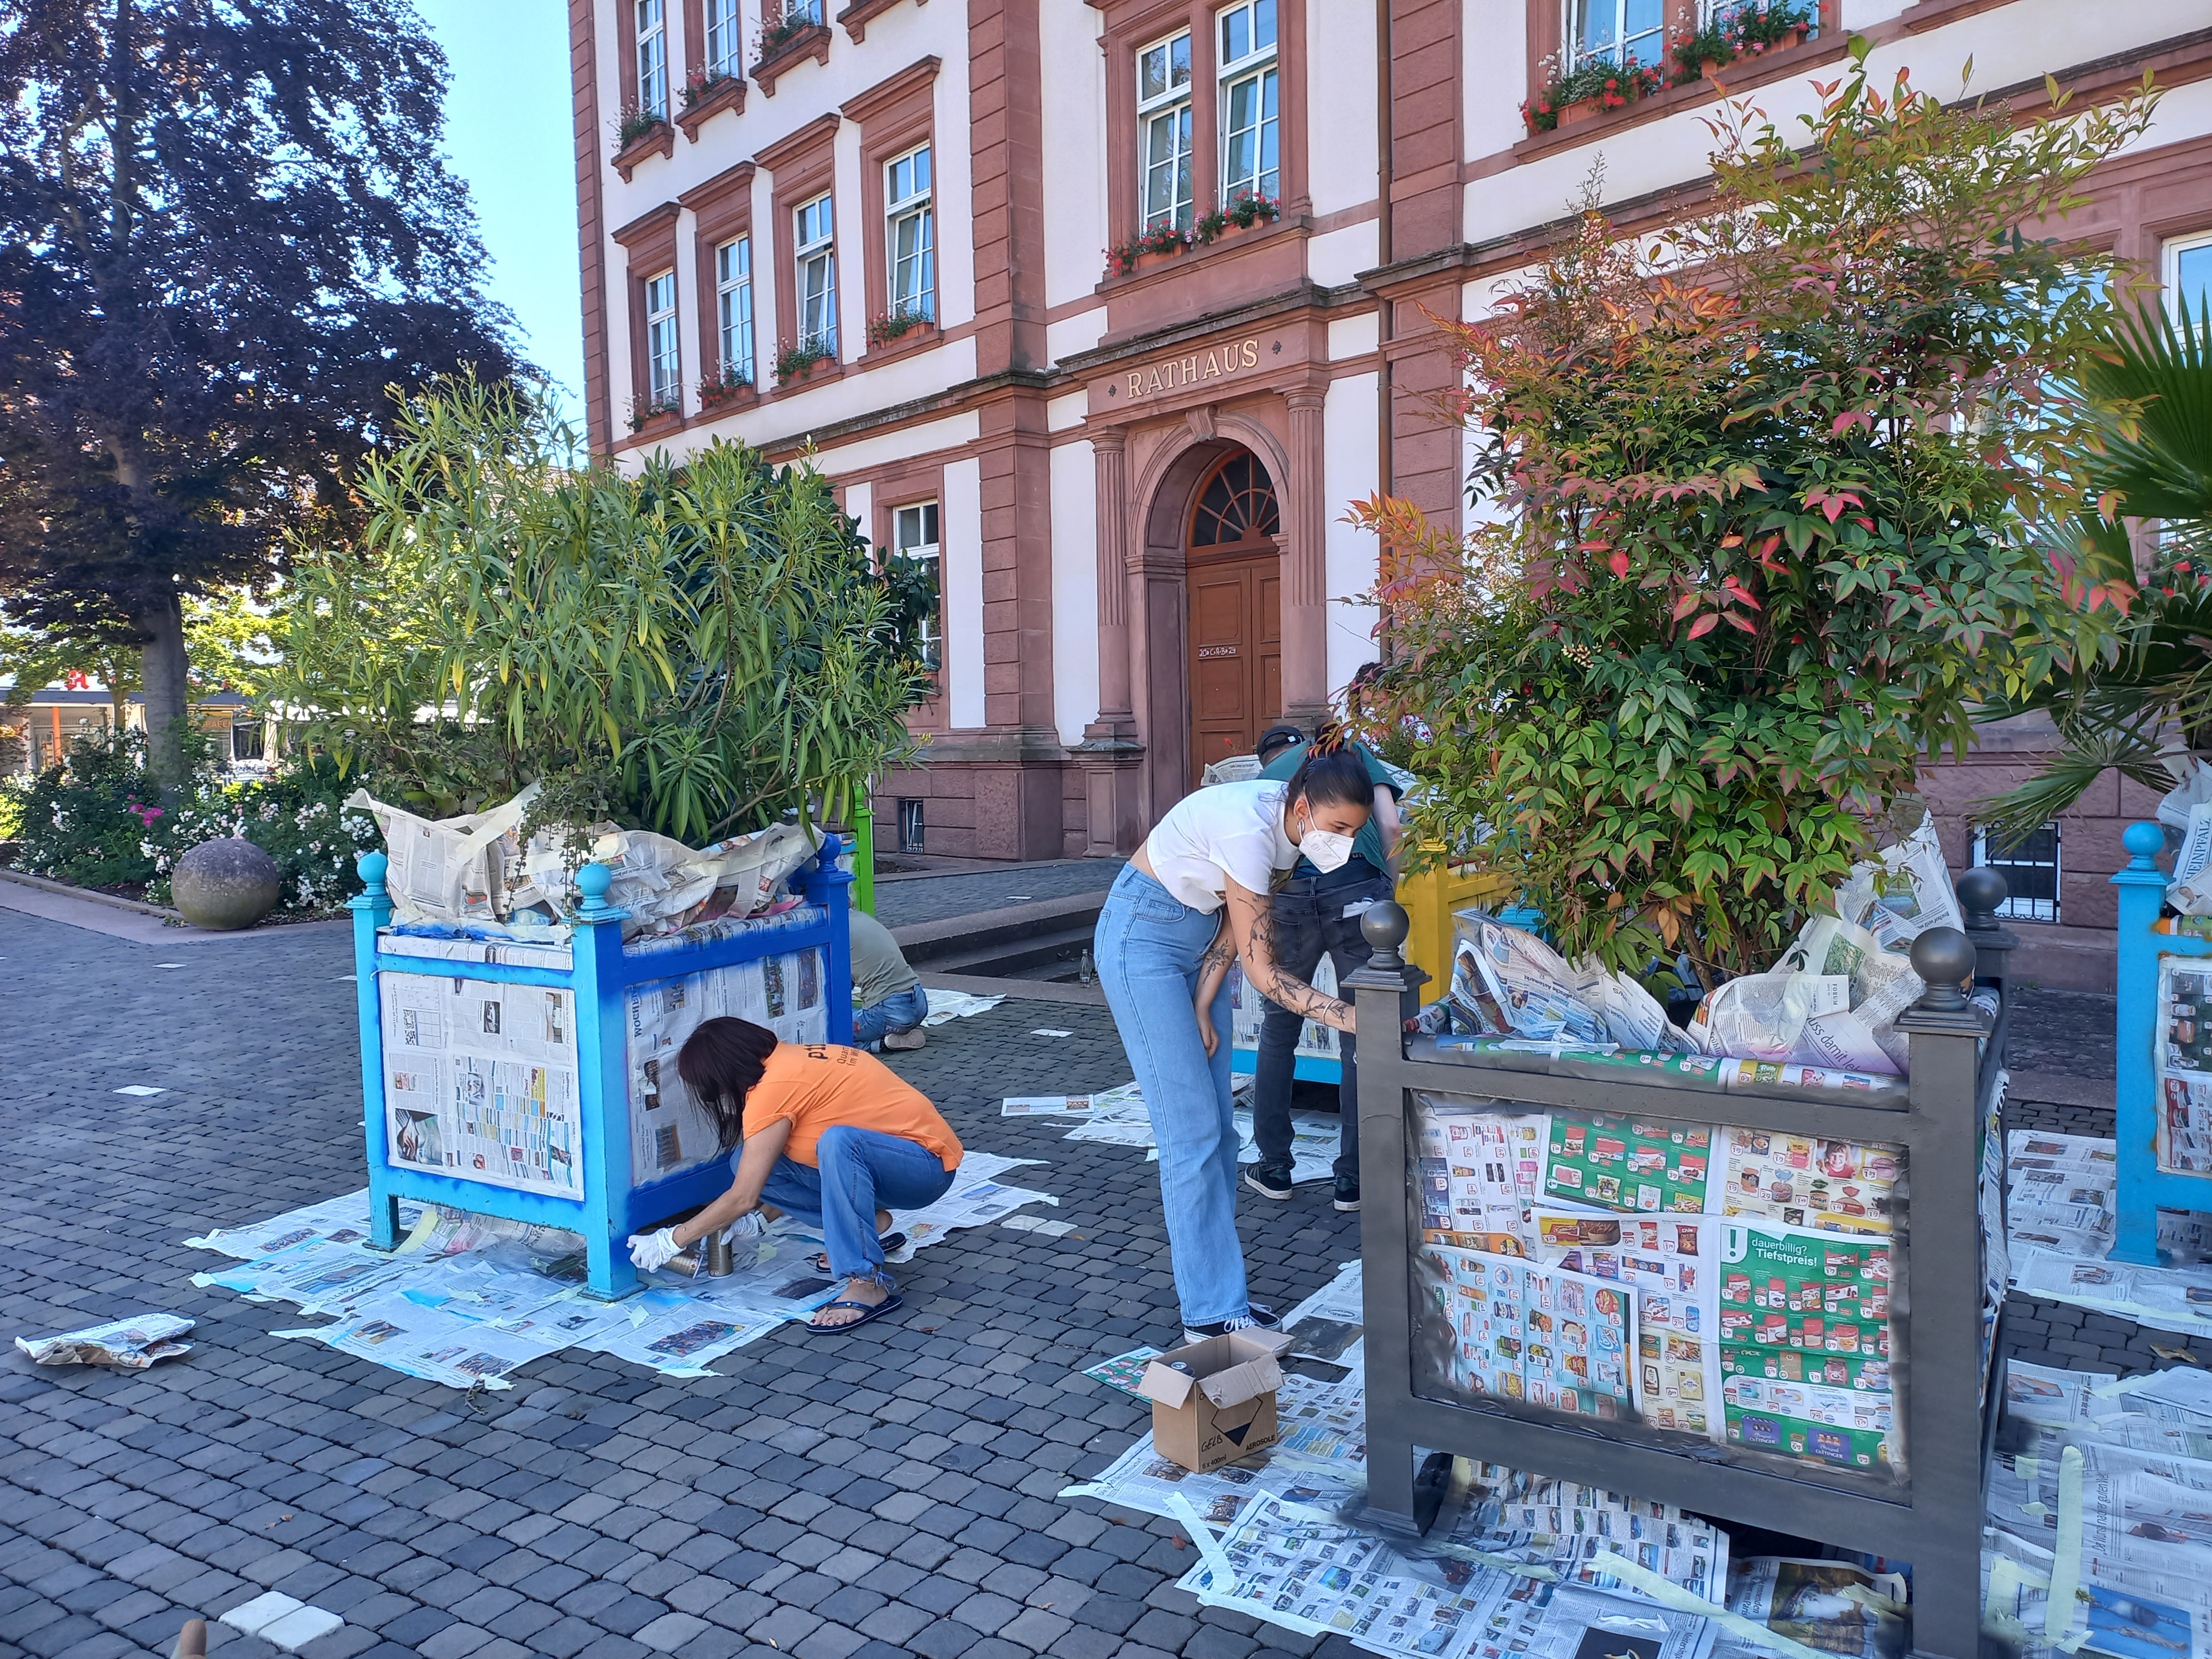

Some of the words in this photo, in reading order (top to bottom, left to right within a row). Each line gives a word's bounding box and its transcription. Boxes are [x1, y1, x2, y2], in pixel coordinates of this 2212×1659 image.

[1127, 339, 1259, 399] RATHAUS
[630, 983, 643, 1038] WOCHEN
[1808, 1016, 1823, 1036] uss
[1820, 1031, 1848, 1063] damit
[1751, 1238, 1807, 1255] dauerbillig?
[1755, 1248, 1818, 1267] Tiefstpreis!
[1201, 1434, 1223, 1452] GELB
[1245, 1434, 1275, 1452] AEROSOLE
[1211, 1454, 1227, 1466] 400ml
[1741, 1600, 1752, 1616] Paris
